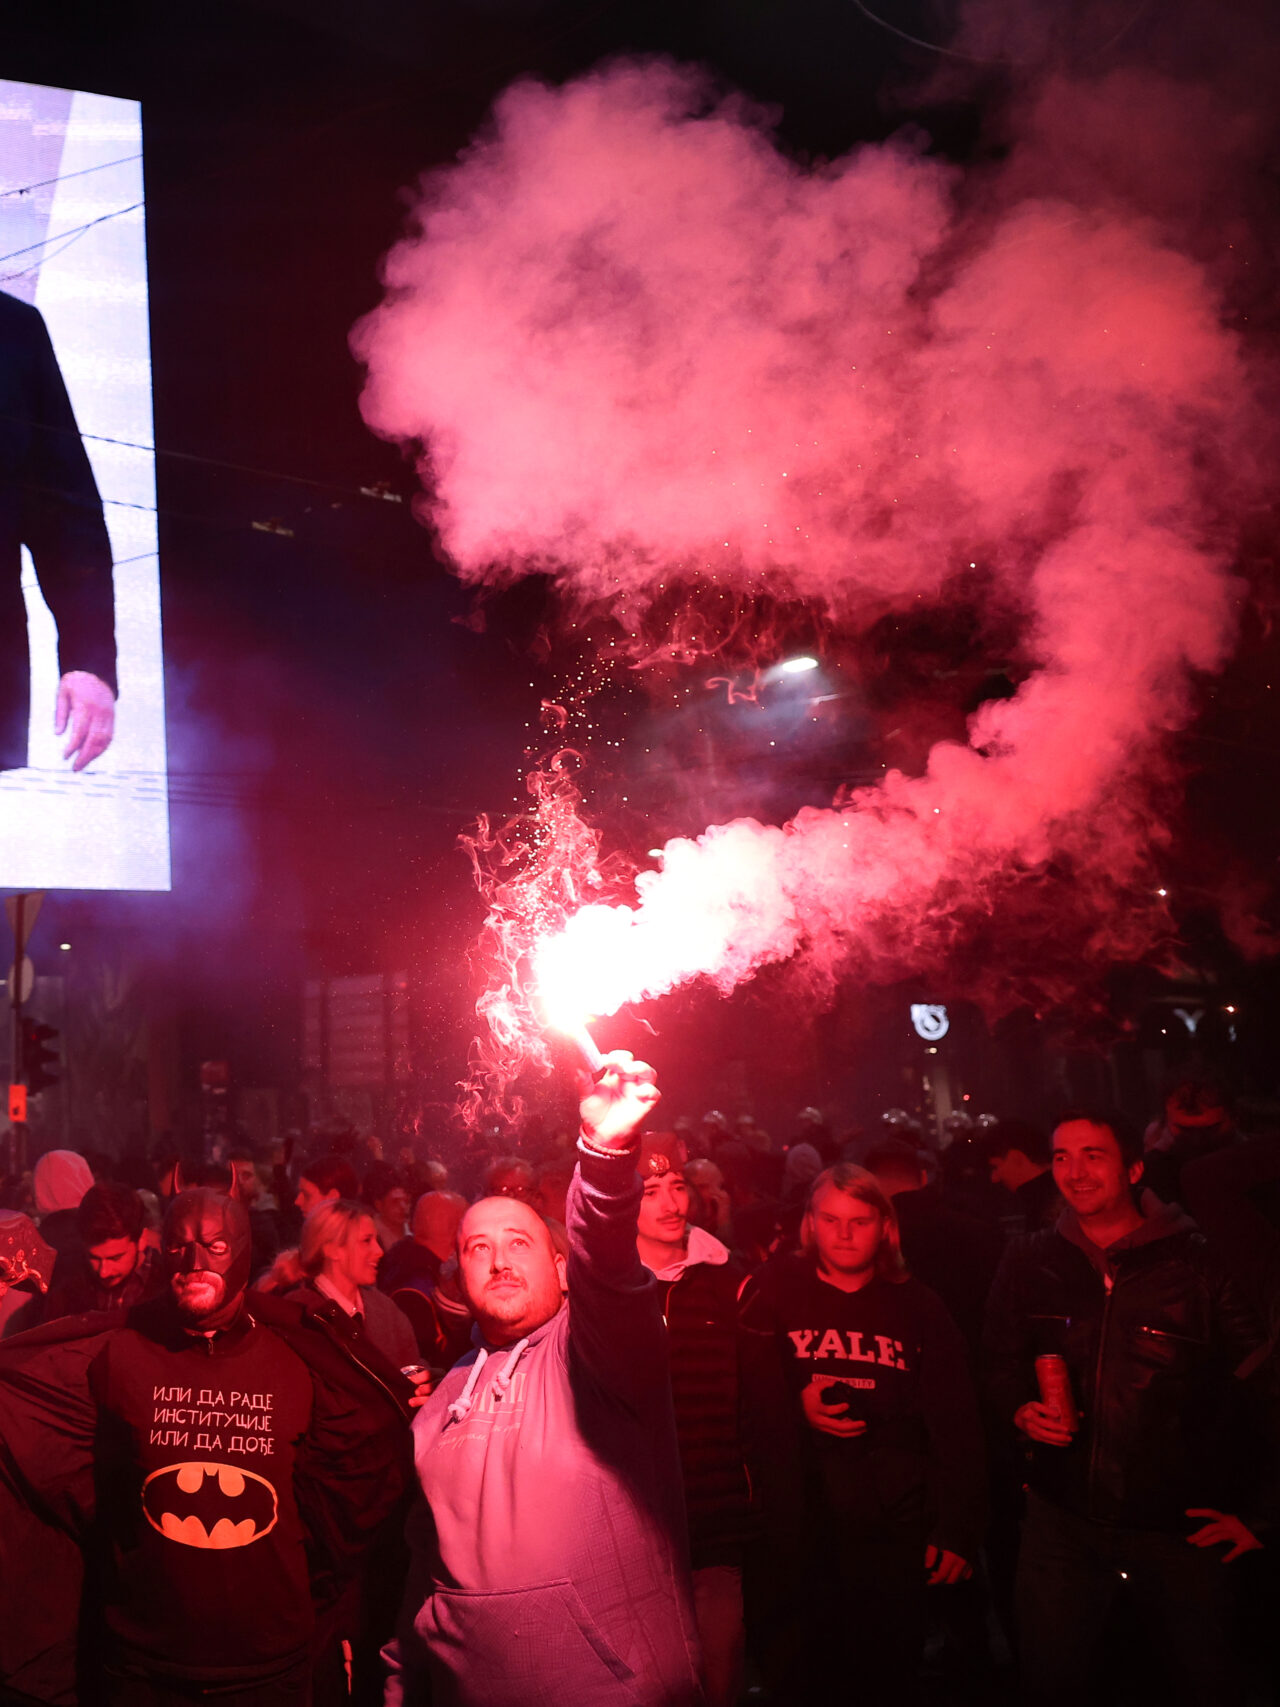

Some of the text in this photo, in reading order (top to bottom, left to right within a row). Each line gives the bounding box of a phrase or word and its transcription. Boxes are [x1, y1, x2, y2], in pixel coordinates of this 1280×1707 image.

[787, 1329, 910, 1371] YALE
[153, 1386, 274, 1412] ИЛИ ДА РАДЕ
[153, 1407, 272, 1432] ИНСТИТУЦИЈЕ
[150, 1429, 275, 1456] ИЛИ ДА ДОЂЕ
